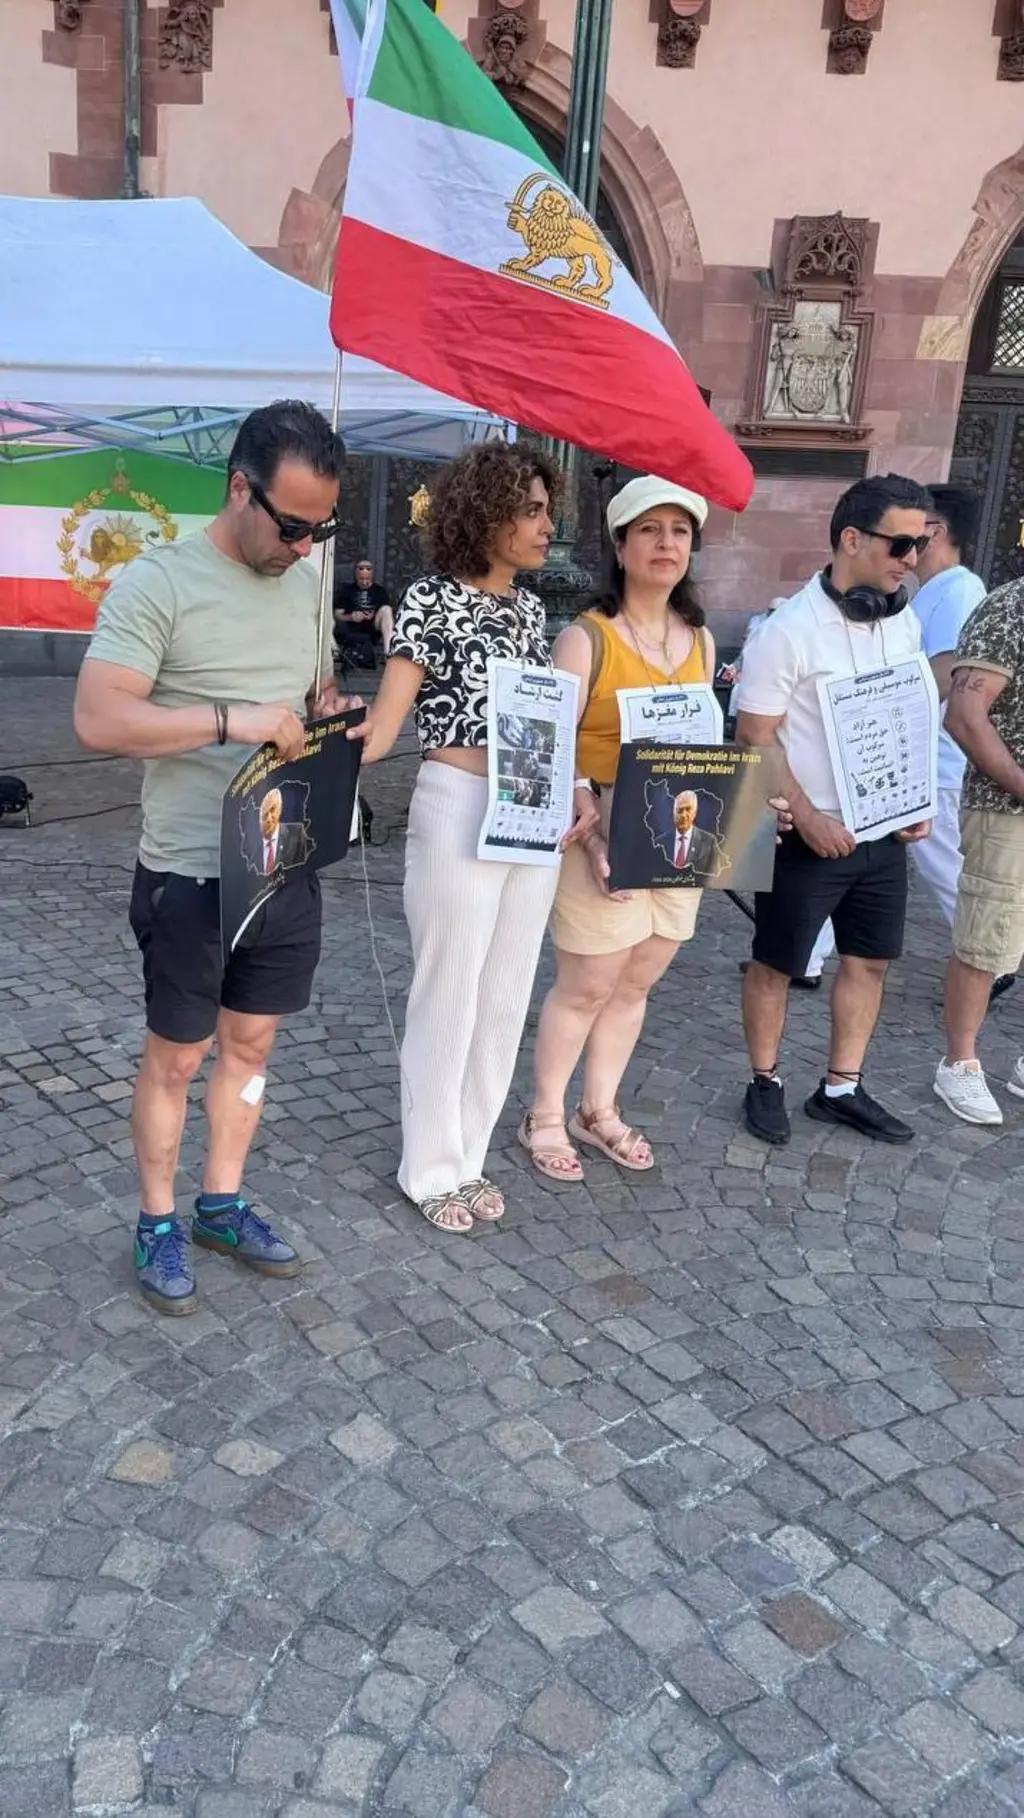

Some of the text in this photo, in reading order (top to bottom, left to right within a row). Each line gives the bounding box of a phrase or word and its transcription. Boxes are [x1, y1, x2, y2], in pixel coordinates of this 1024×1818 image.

[641, 699, 702, 721] فرار مغزها
[636, 749, 673, 761] Solidarität
[674, 749, 685, 760] für
[685, 750, 728, 761] Demokratie
[651, 762, 735, 776] mit König Reza Pahlavi
